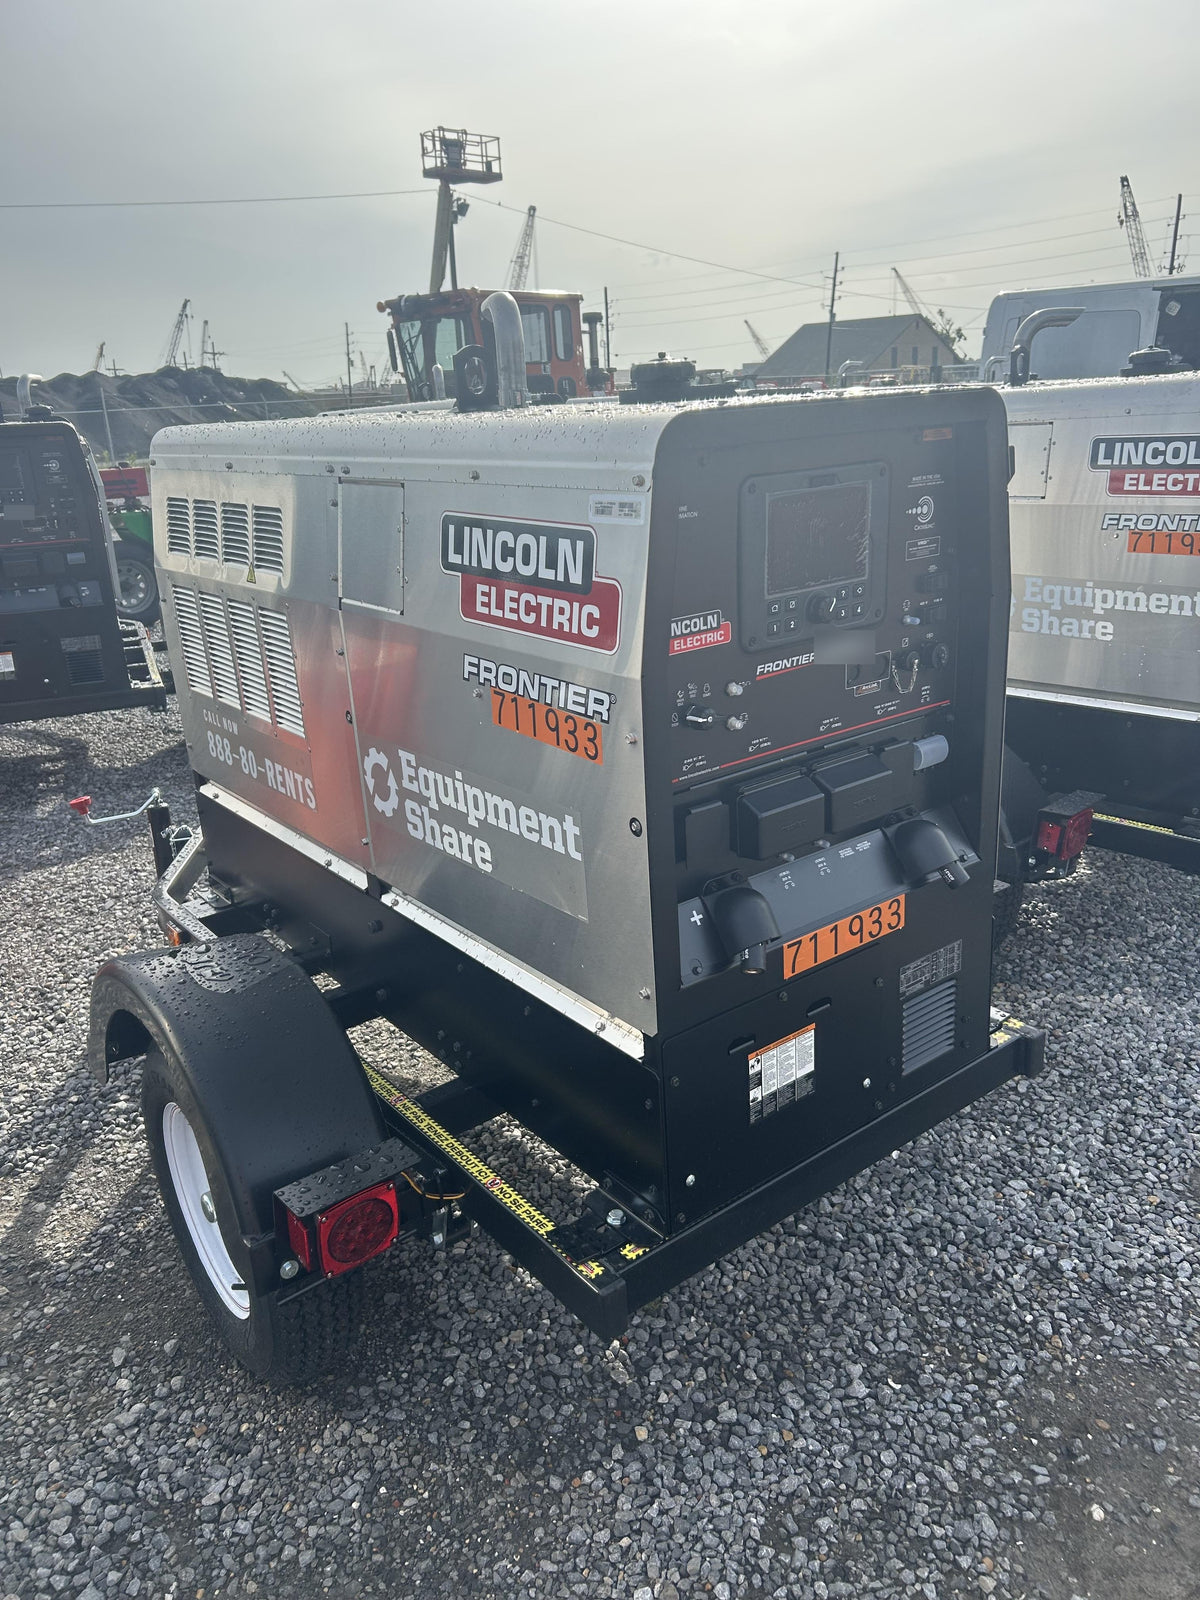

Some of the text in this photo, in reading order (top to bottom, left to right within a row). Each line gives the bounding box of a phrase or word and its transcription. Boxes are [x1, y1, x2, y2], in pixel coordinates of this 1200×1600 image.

[1097, 440, 1200, 466] LINCOL
[1123, 472, 1200, 492] ELECT
[447, 523, 585, 585] LINCOLN
[1131, 531, 1200, 555] 7119
[475, 584, 601, 638] ELECTRIC
[840, 609, 846, 617] 3
[1023, 576, 1200, 618] Equipment
[673, 630, 725, 651] ELECTRIC
[1021, 607, 1114, 642] Share
[203, 708, 238, 735] CALL NOW
[493, 689, 600, 762] 711933
[207, 730, 316, 810] 888-80-RENTS
[398, 748, 582, 862] Equipment
[405, 797, 494, 873] Share
[786, 898, 902, 973] 711933
[400, 1102, 490, 1180] NE PAS TENEZ DEBOUT ICI
[496, 1187, 549, 1230] NO SE PARE
